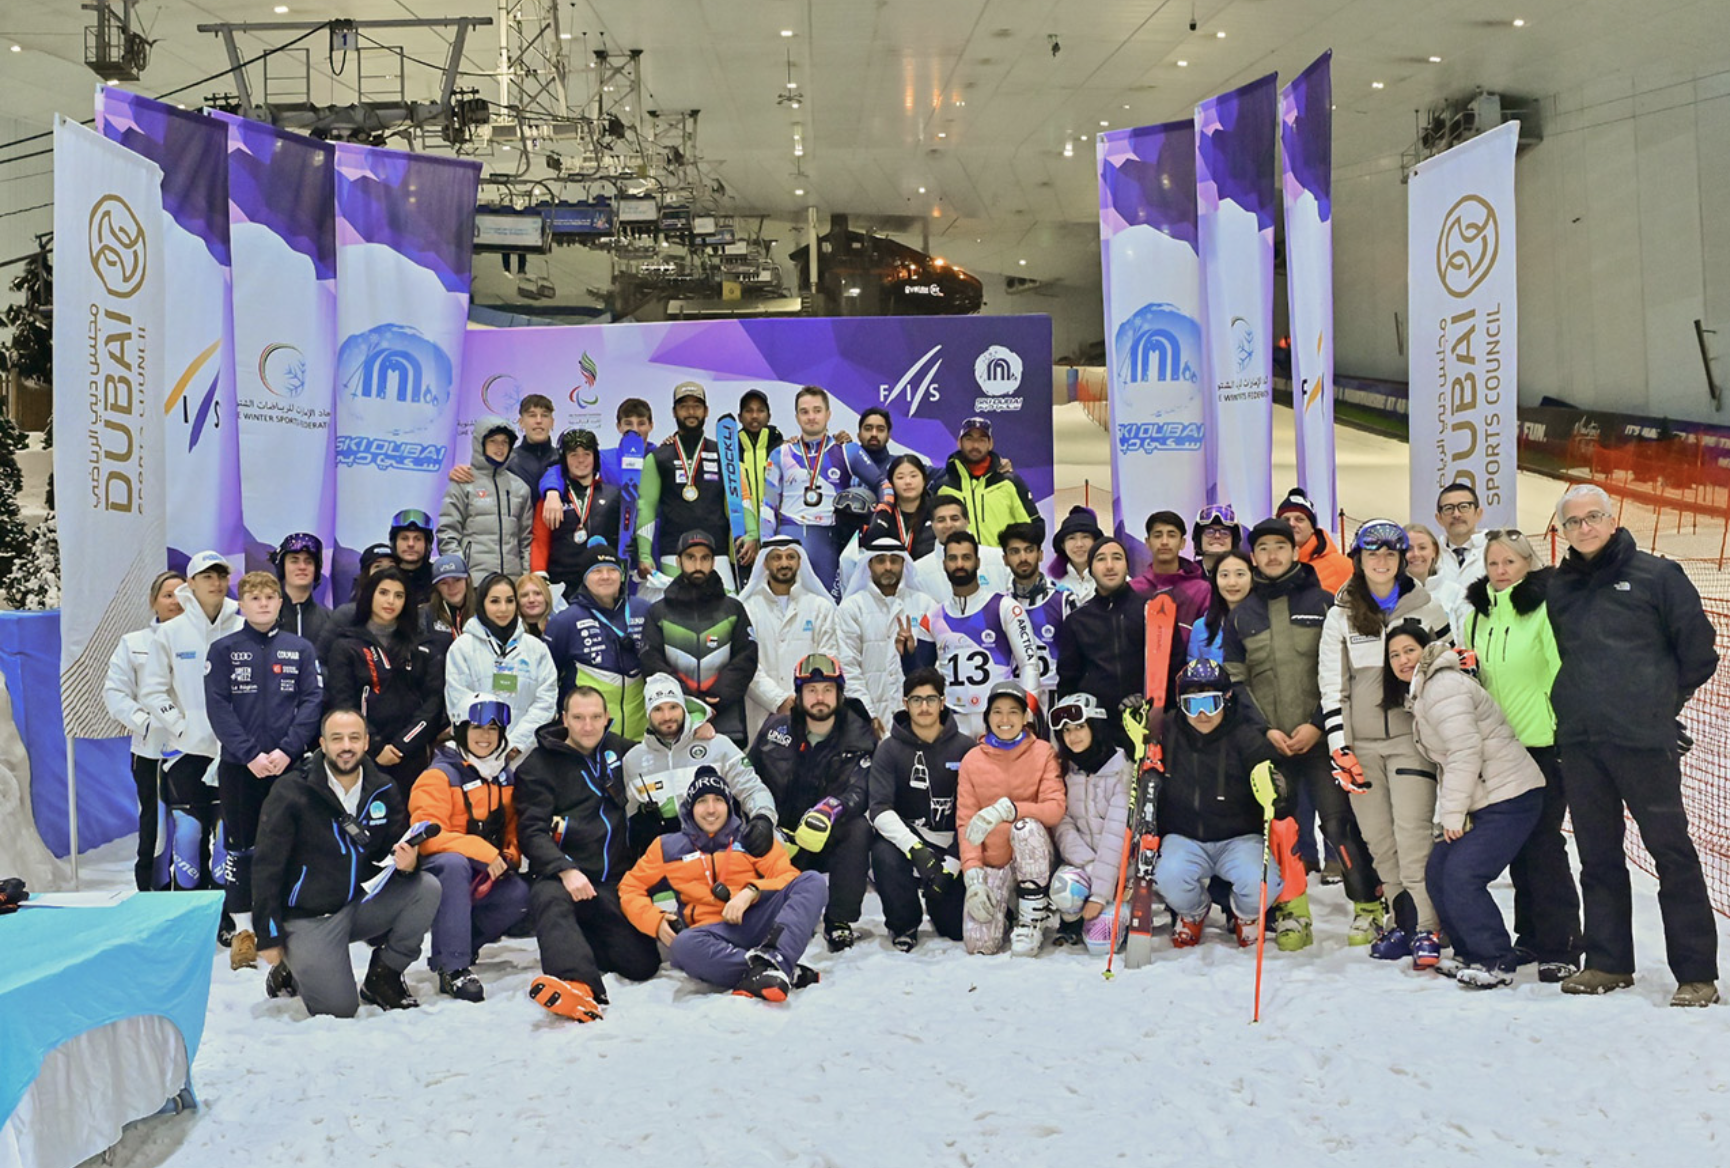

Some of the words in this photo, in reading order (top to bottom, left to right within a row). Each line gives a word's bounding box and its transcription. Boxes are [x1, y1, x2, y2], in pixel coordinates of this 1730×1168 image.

[340, 33, 348, 47] 1
[1484, 302, 1501, 406] COUNCIL
[104, 308, 134, 513] DUBAI
[244, 413, 275, 423] WINTER
[1139, 424, 1204, 438] DUBAI
[372, 440, 446, 460] DUBAI
[1484, 413, 1501, 507] SPORTS
[1017, 618, 1035, 662] ARCTICA
[947, 651, 990, 687] 13
